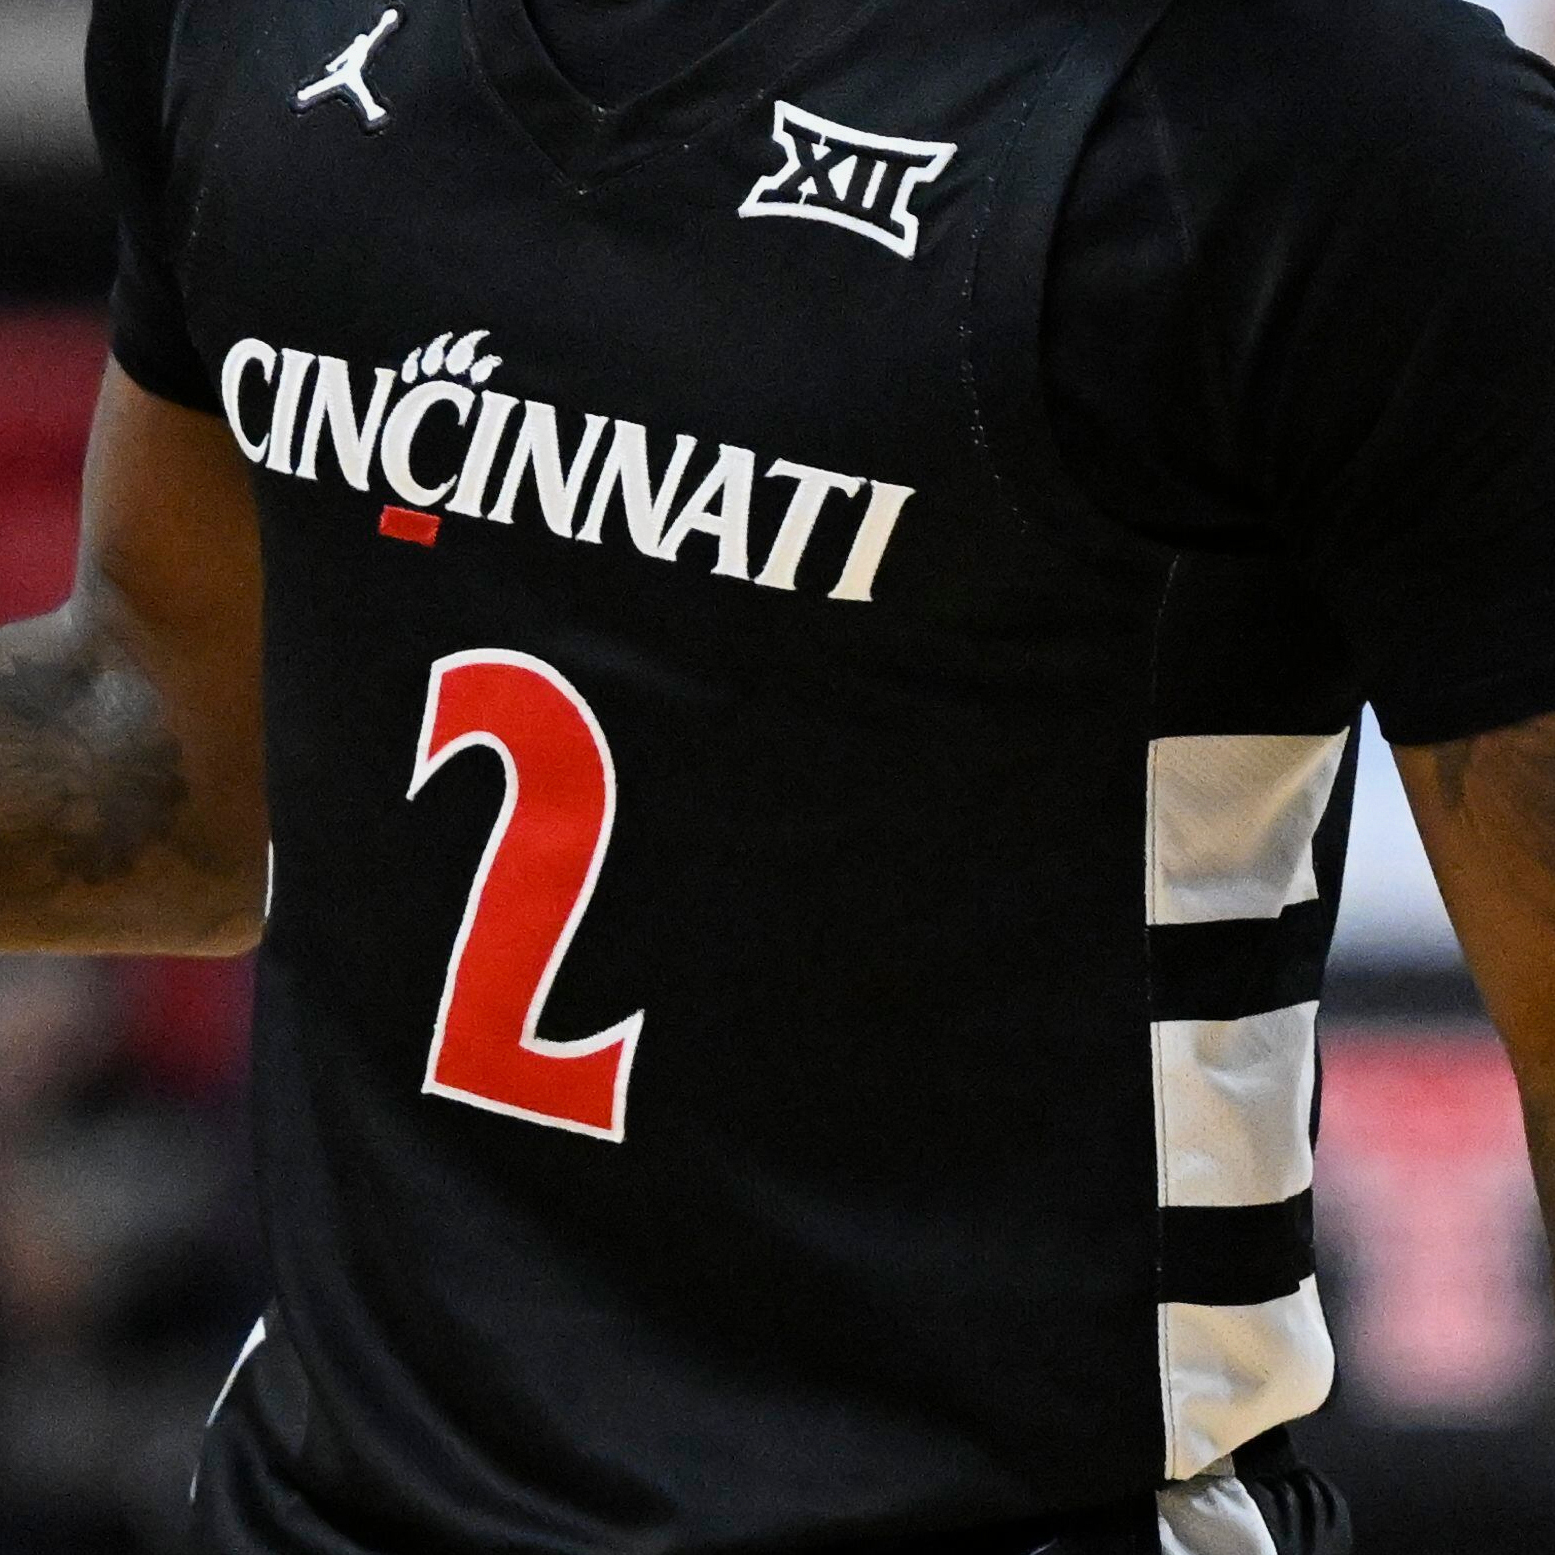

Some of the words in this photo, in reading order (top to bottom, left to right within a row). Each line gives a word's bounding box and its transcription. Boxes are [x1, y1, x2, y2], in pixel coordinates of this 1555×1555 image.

[751, 113, 942, 244] XII
[221, 336, 916, 603] CINCINNATI
[405, 647, 645, 1144] 2
